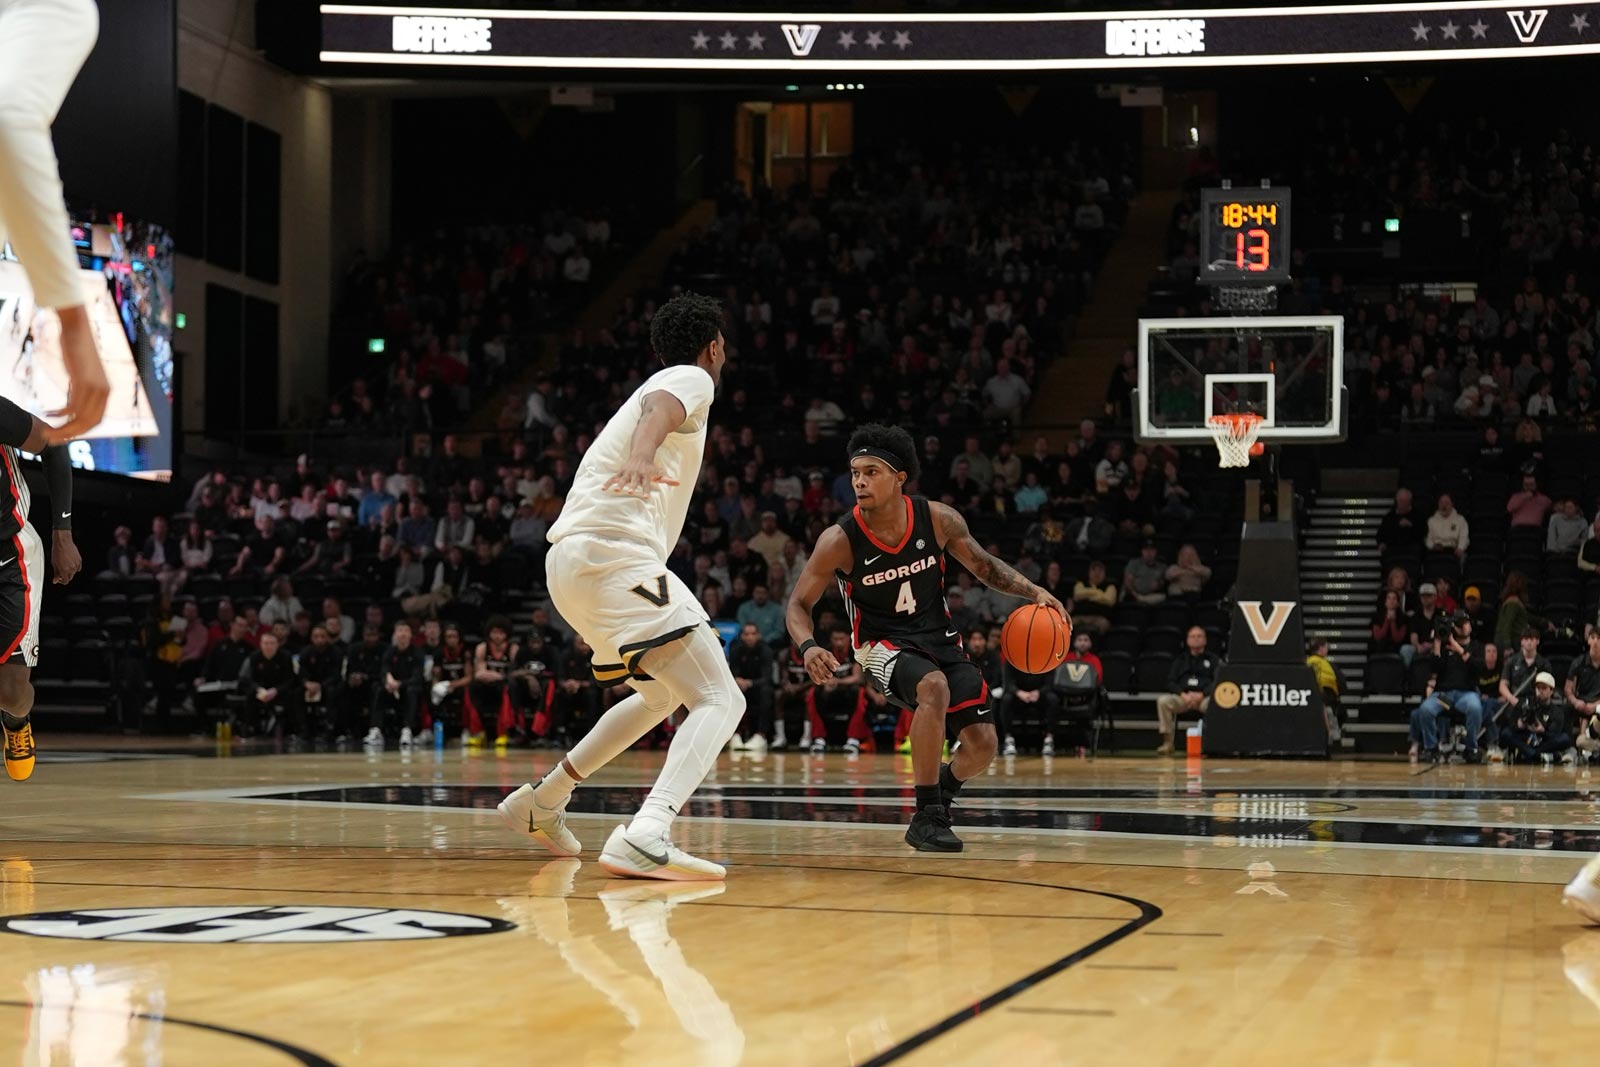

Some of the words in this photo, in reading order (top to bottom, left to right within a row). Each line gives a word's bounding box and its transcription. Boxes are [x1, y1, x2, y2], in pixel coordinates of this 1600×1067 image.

[393, 16, 493, 53] DEFENSE
[1106, 19, 1206, 56] DEFENSE
[1222, 202, 1277, 228] 18:44
[1236, 229, 1270, 272] 13
[862, 555, 937, 586] GEORGIA
[628, 574, 670, 608] V
[895, 580, 917, 615] 4
[1237, 601, 1297, 645] V
[1066, 663, 1089, 683] V
[1240, 683, 1312, 707] Hiller
